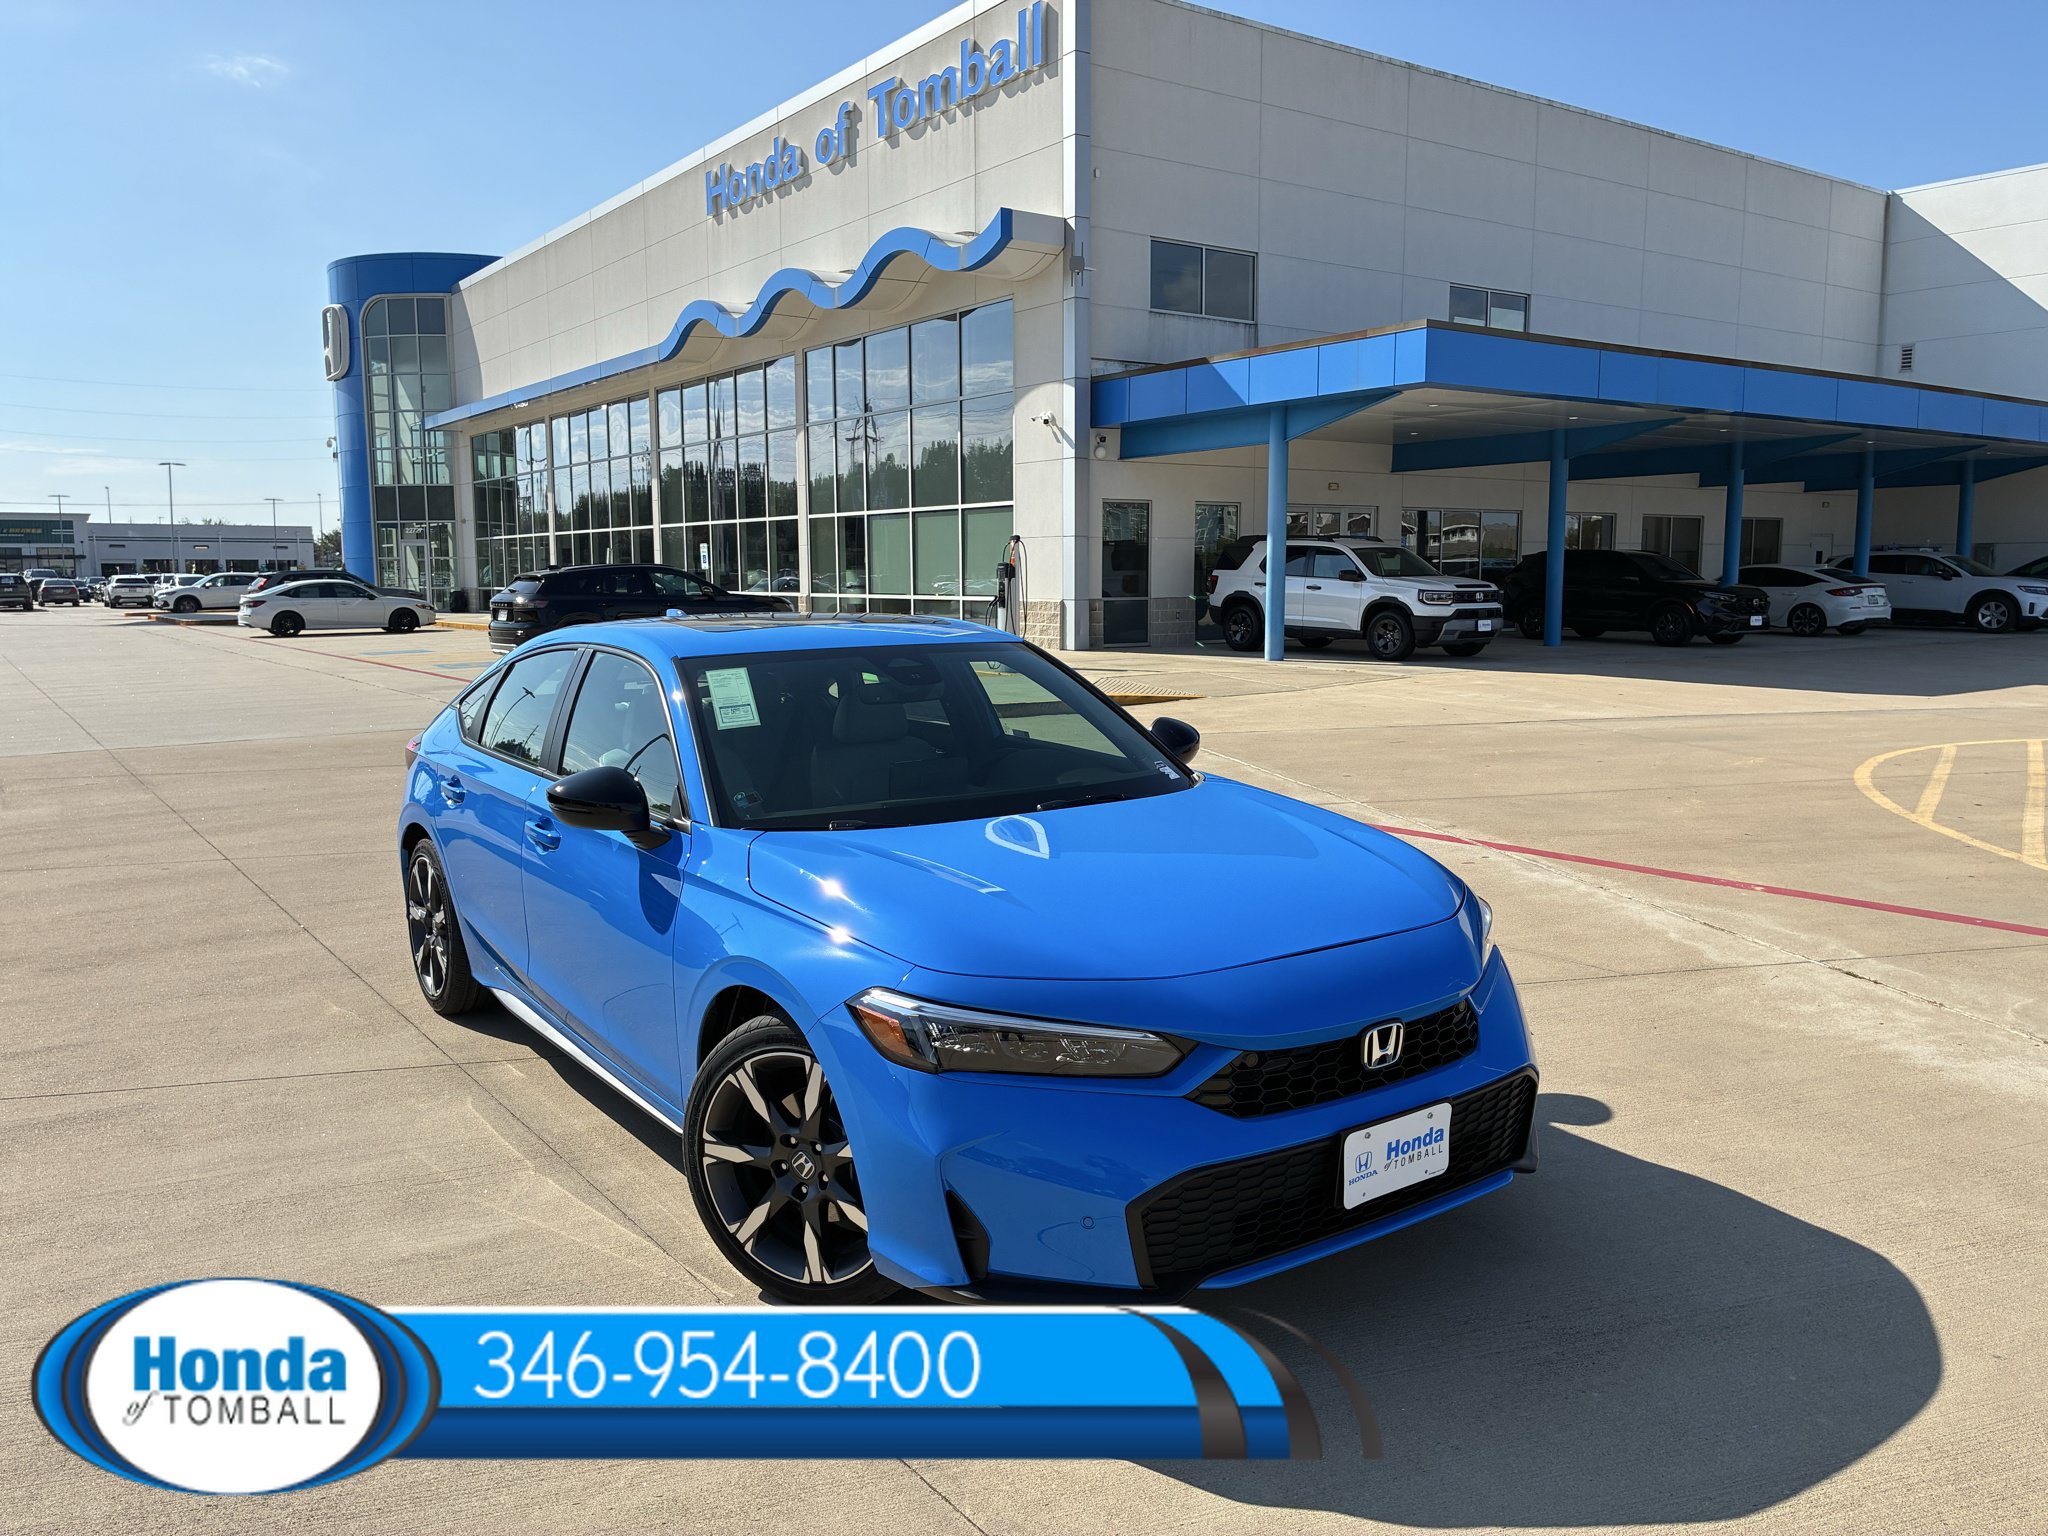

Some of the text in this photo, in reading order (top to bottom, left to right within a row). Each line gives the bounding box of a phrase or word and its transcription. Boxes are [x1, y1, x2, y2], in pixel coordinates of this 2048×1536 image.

[705, 0, 1046, 217] Honda of Tomball
[1383, 1144, 1444, 1172] of TOMBALL
[1386, 1126, 1445, 1161] Honda
[1348, 1169, 1378, 1186] HONDA
